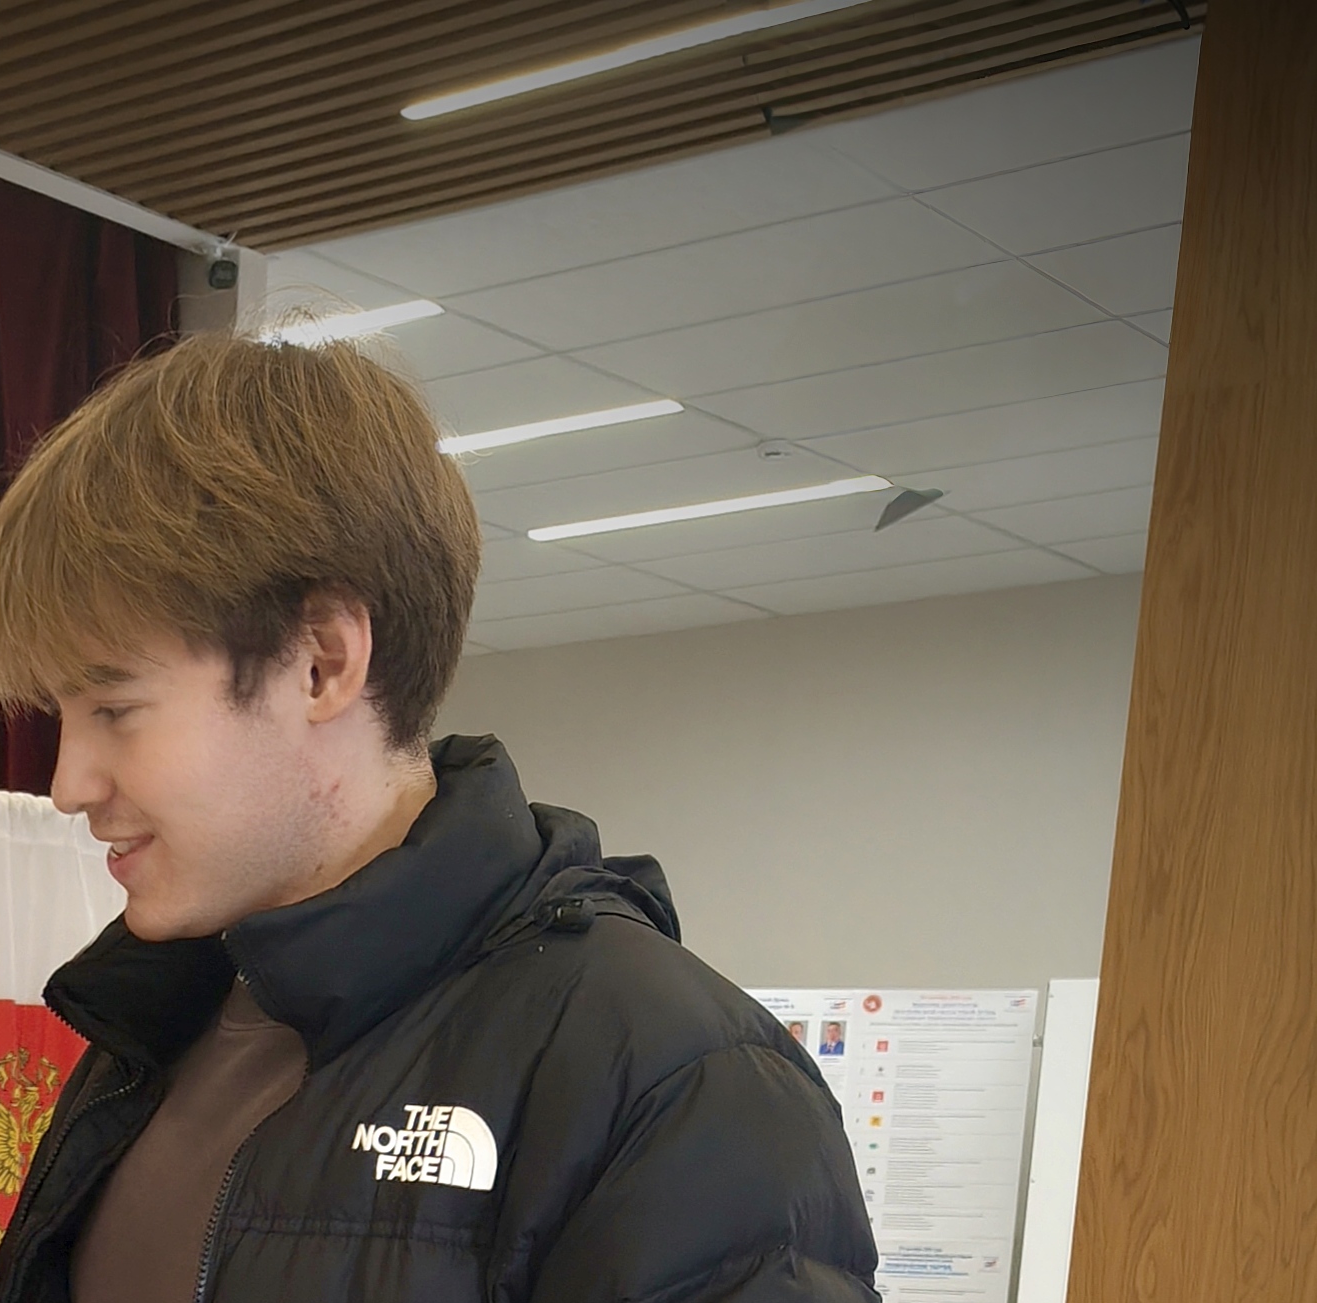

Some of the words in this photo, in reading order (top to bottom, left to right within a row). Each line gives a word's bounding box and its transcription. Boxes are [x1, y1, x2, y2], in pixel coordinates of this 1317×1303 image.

[403, 1104, 453, 1131] THE
[351, 1122, 446, 1157] NORTH
[375, 1153, 441, 1183] FACE
